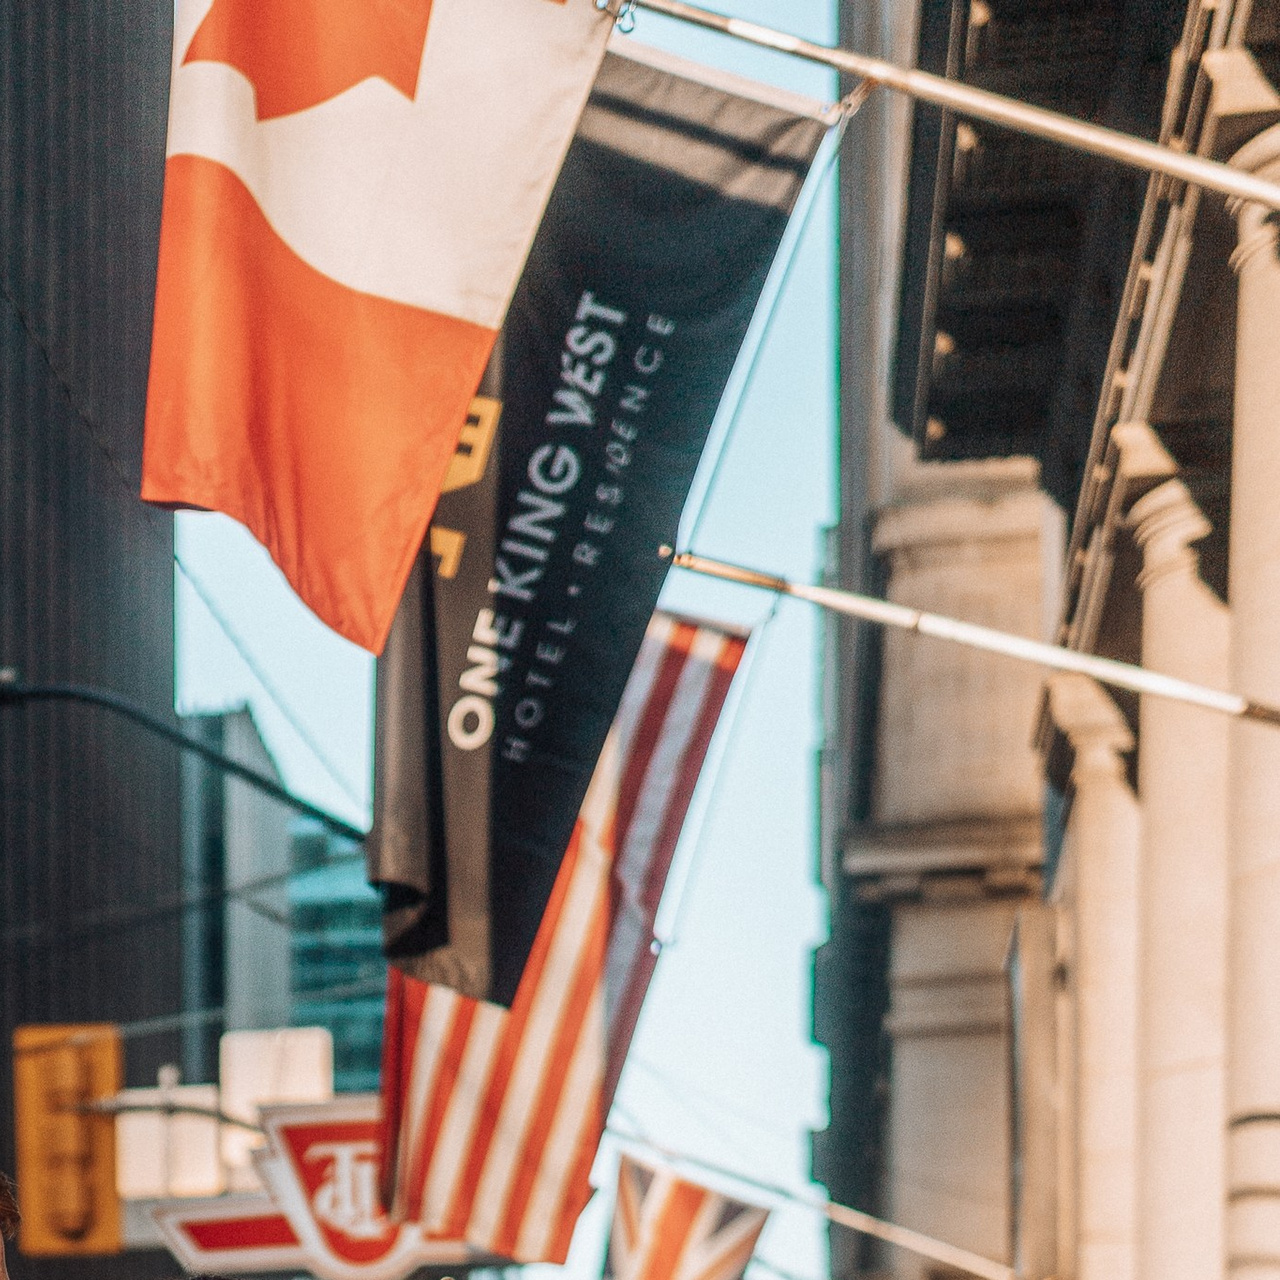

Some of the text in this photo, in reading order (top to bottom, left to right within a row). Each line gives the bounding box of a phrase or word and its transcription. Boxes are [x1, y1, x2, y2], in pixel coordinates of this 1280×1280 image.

[447, 288, 627, 750] ONE KING WEST
[501, 617, 578, 762] HOTEL
